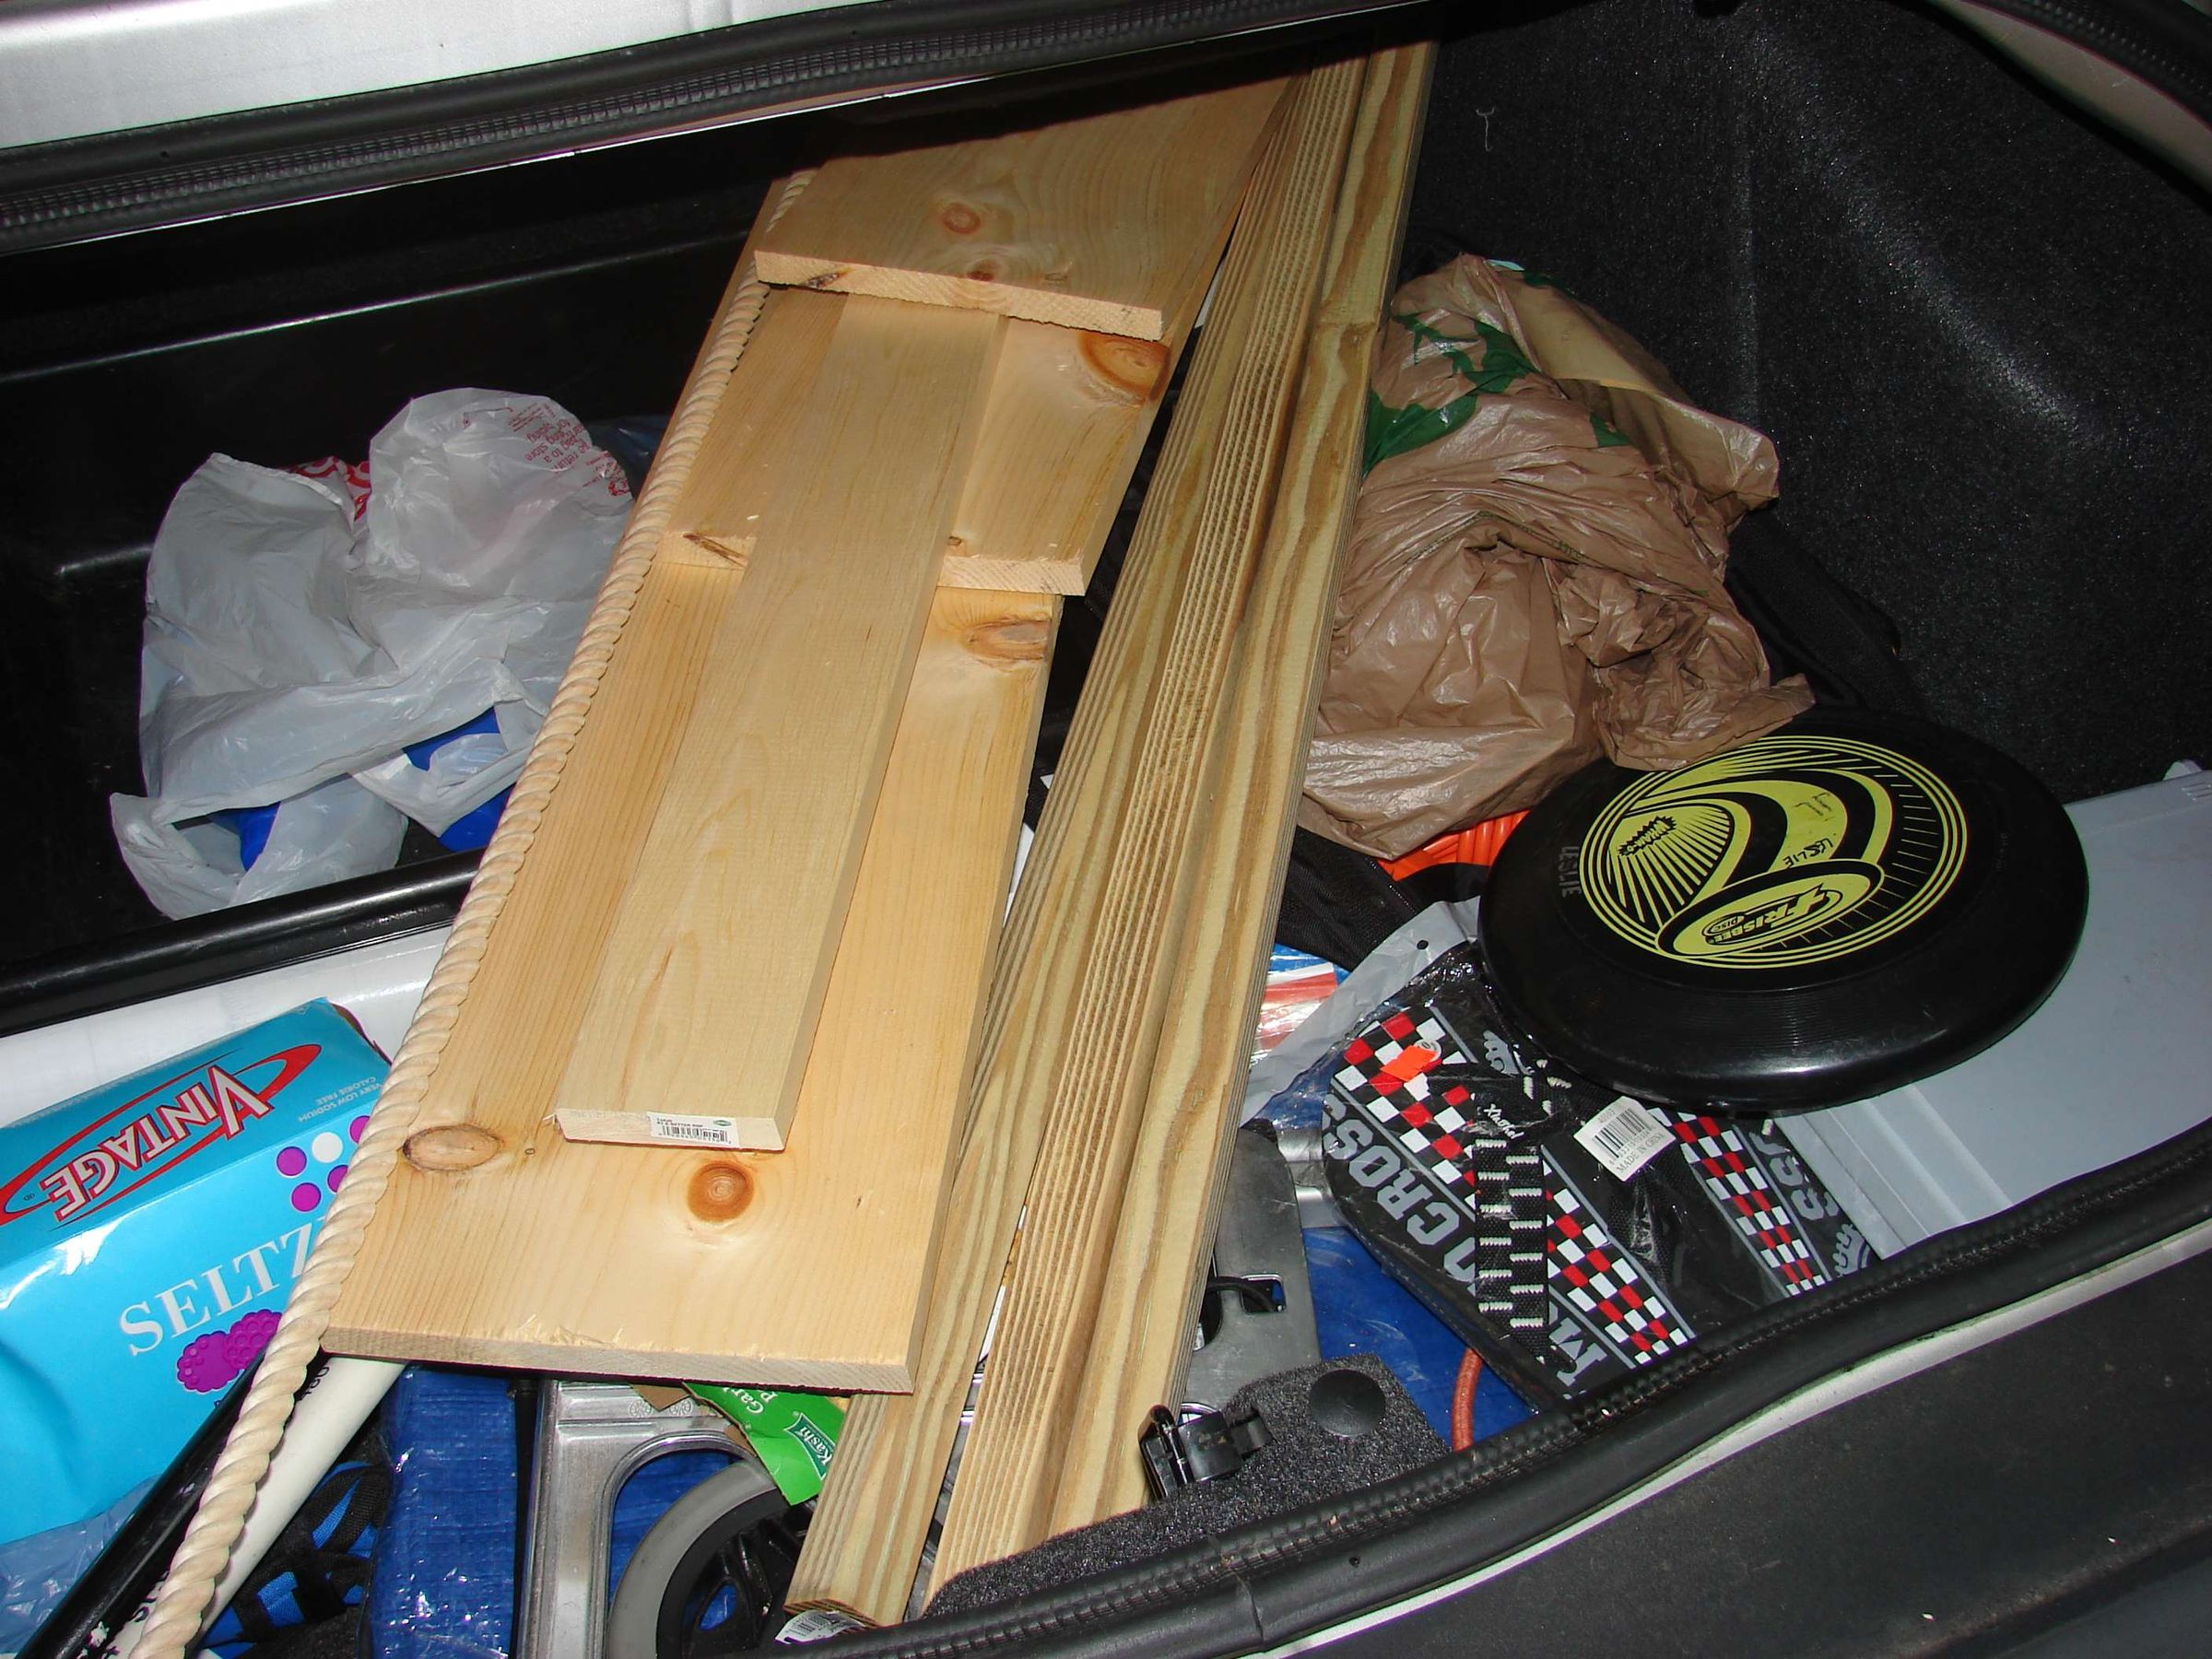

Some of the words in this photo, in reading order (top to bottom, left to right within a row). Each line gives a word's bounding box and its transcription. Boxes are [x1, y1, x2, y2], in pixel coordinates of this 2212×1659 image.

[1783, 837, 1834, 869] LESLIE
[315, 1091, 338, 1106] FREE
[337, 1091, 359, 1106] LOW
[338, 1076, 377, 1095] CALORIE
[298, 1101, 338, 1123] SODIUM
[39, 1065, 275, 1222] VINTAGE
[1322, 1093, 1460, 1246] CROSS
[1616, 1151, 1640, 1171] MADE
[118, 1215, 329, 1357] SELTZ
[795, 1425, 833, 1465] Kashi
